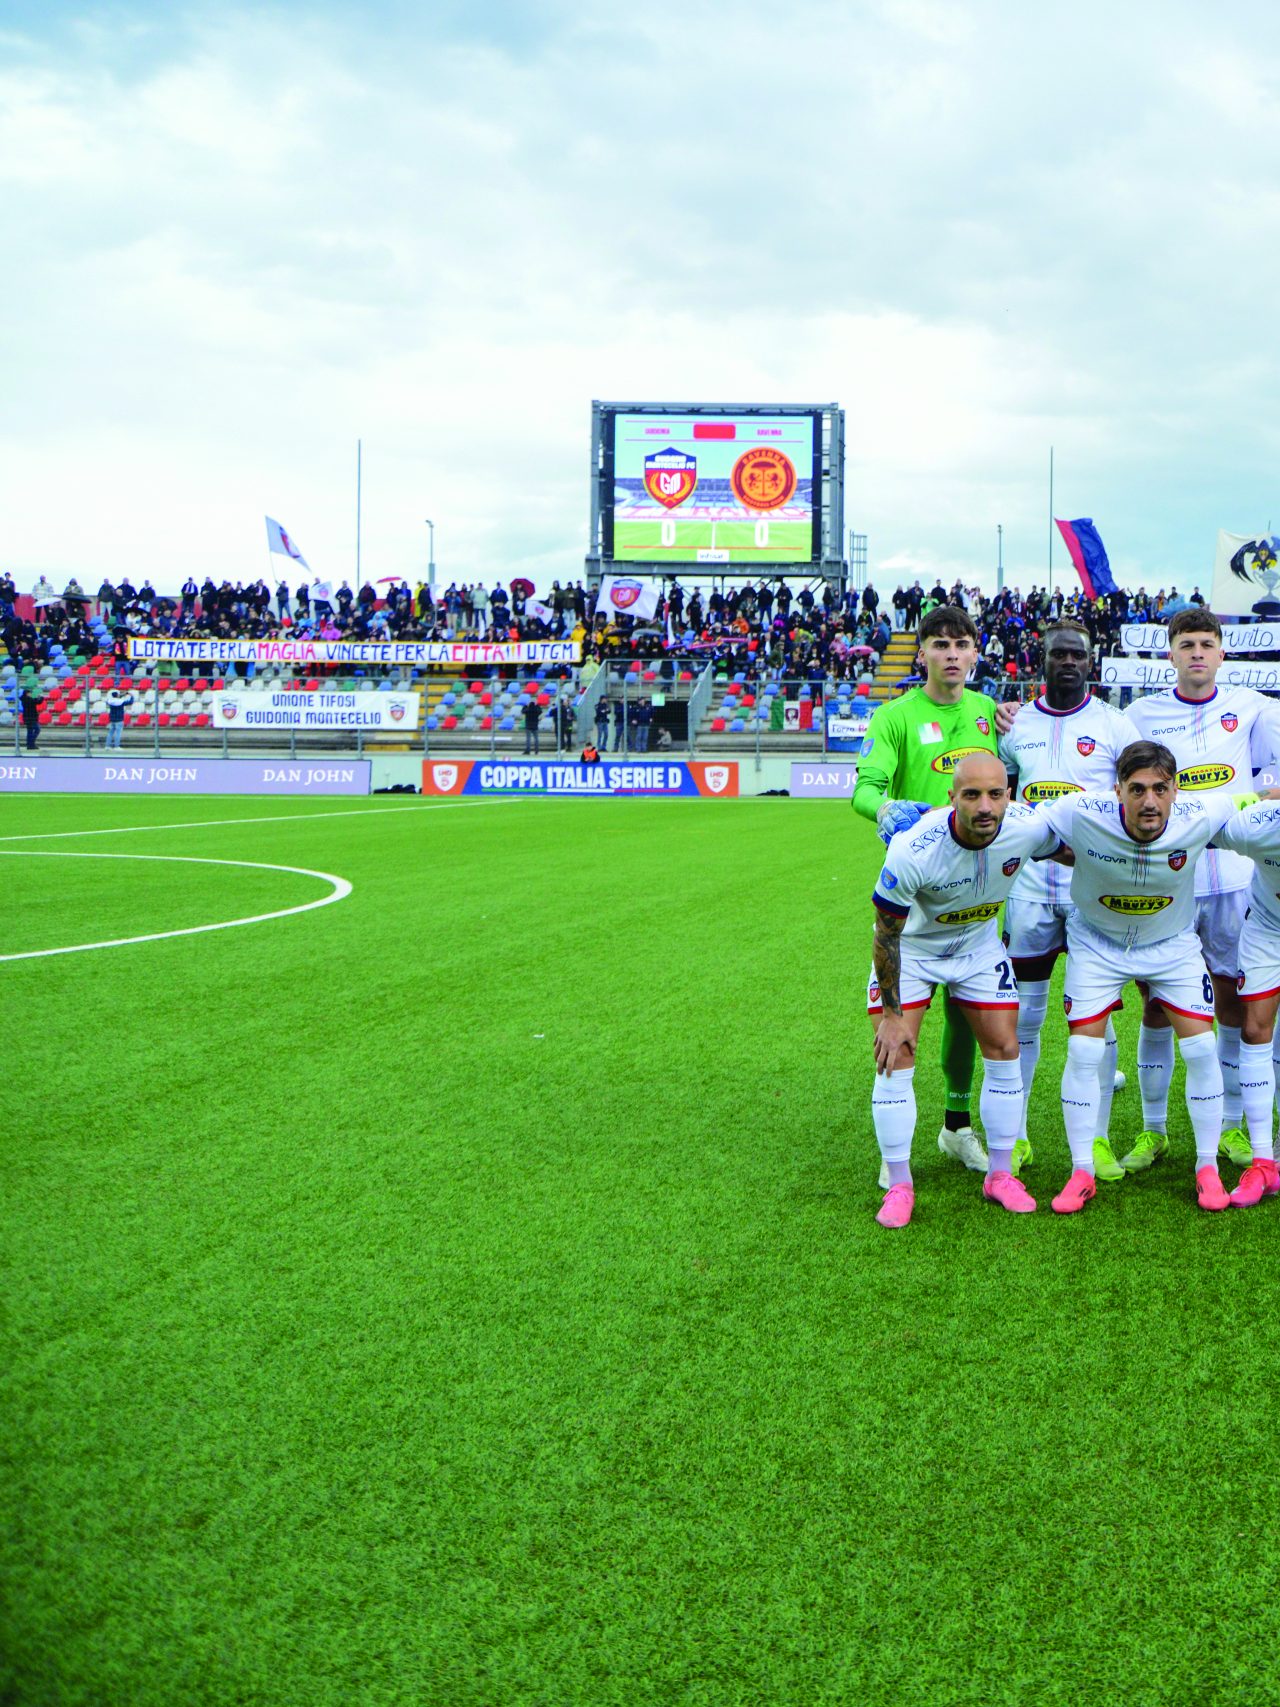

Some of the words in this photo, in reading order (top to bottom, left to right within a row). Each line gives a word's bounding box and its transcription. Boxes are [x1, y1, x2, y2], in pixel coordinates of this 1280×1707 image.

[661, 519, 676, 547] 0
[754, 520, 769, 548] 0
[133, 640, 207, 658] LOTTATE
[326, 643, 392, 660] VINCETE
[395, 644, 426, 661] PER
[428, 644, 449, 661] LA
[272, 694, 314, 707] UNIONE
[320, 694, 356, 708] TIFOSI
[246, 711, 300, 724] GUIDONIA
[305, 712, 381, 725] MONTECELIO
[1152, 725, 1186, 736] GIVOVA
[1014, 741, 1046, 752] GIVOVA
[0, 766, 38, 780] OHN
[104, 767, 145, 781] DAN
[148, 768, 198, 784] JOHN
[263, 769, 301, 782] DAN
[305, 769, 355, 785] JOHN
[480, 765, 544, 788] COPPA
[547, 766, 607, 788] ITALIA
[608, 767, 663, 789] SERIE
[668, 768, 682, 788] D
[802, 772, 840, 785] DAN
[1087, 850, 1127, 865] GIVOVA
[931, 877, 972, 892] GIVOVA
[1190, 1004, 1214, 1013] GIVO
